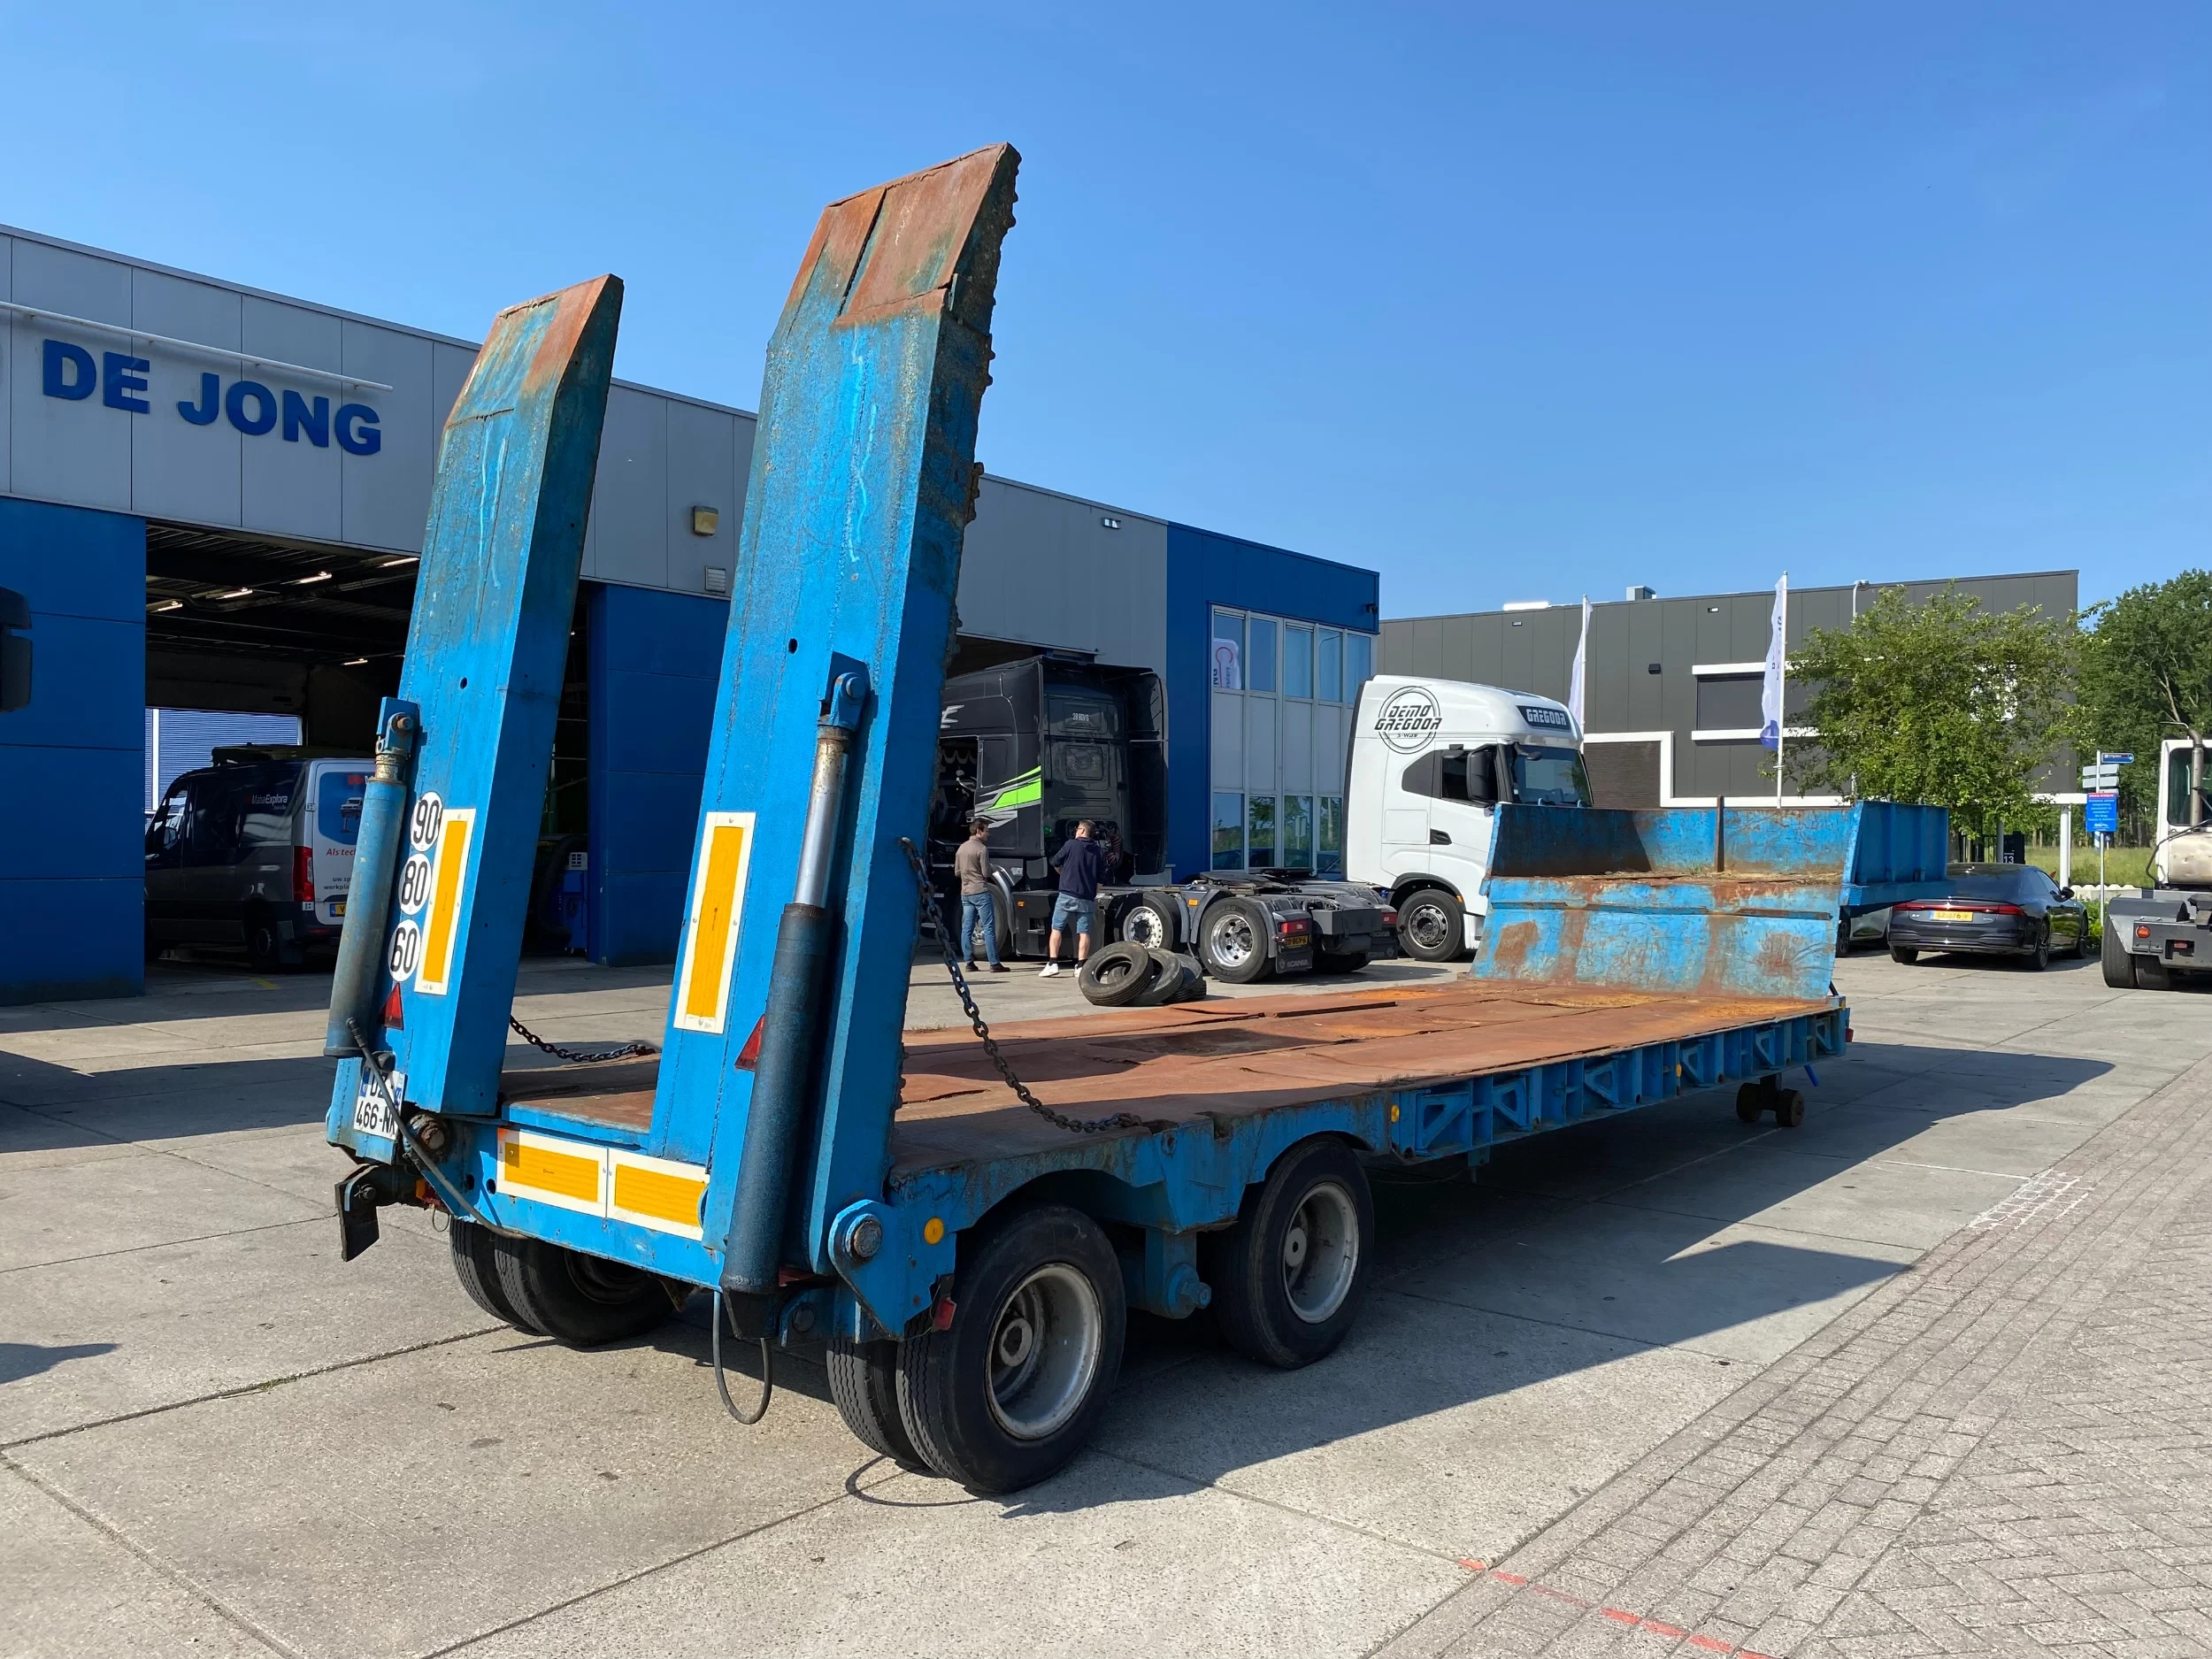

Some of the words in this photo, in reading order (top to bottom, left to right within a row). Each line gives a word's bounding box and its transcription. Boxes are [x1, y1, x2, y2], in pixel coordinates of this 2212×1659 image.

[42, 339, 150, 414] DE
[177, 373, 381, 456] JONG
[1387, 704, 1432, 718] DEMO
[1525, 708, 1567, 726] GREGOOR
[1374, 718, 1442, 730] GREGOOR
[412, 799, 440, 845] 90
[326, 848, 340, 856] Als
[401, 860, 428, 907] 80
[390, 926, 418, 973] 60
[1286, 959, 1309, 968] SCANIA
